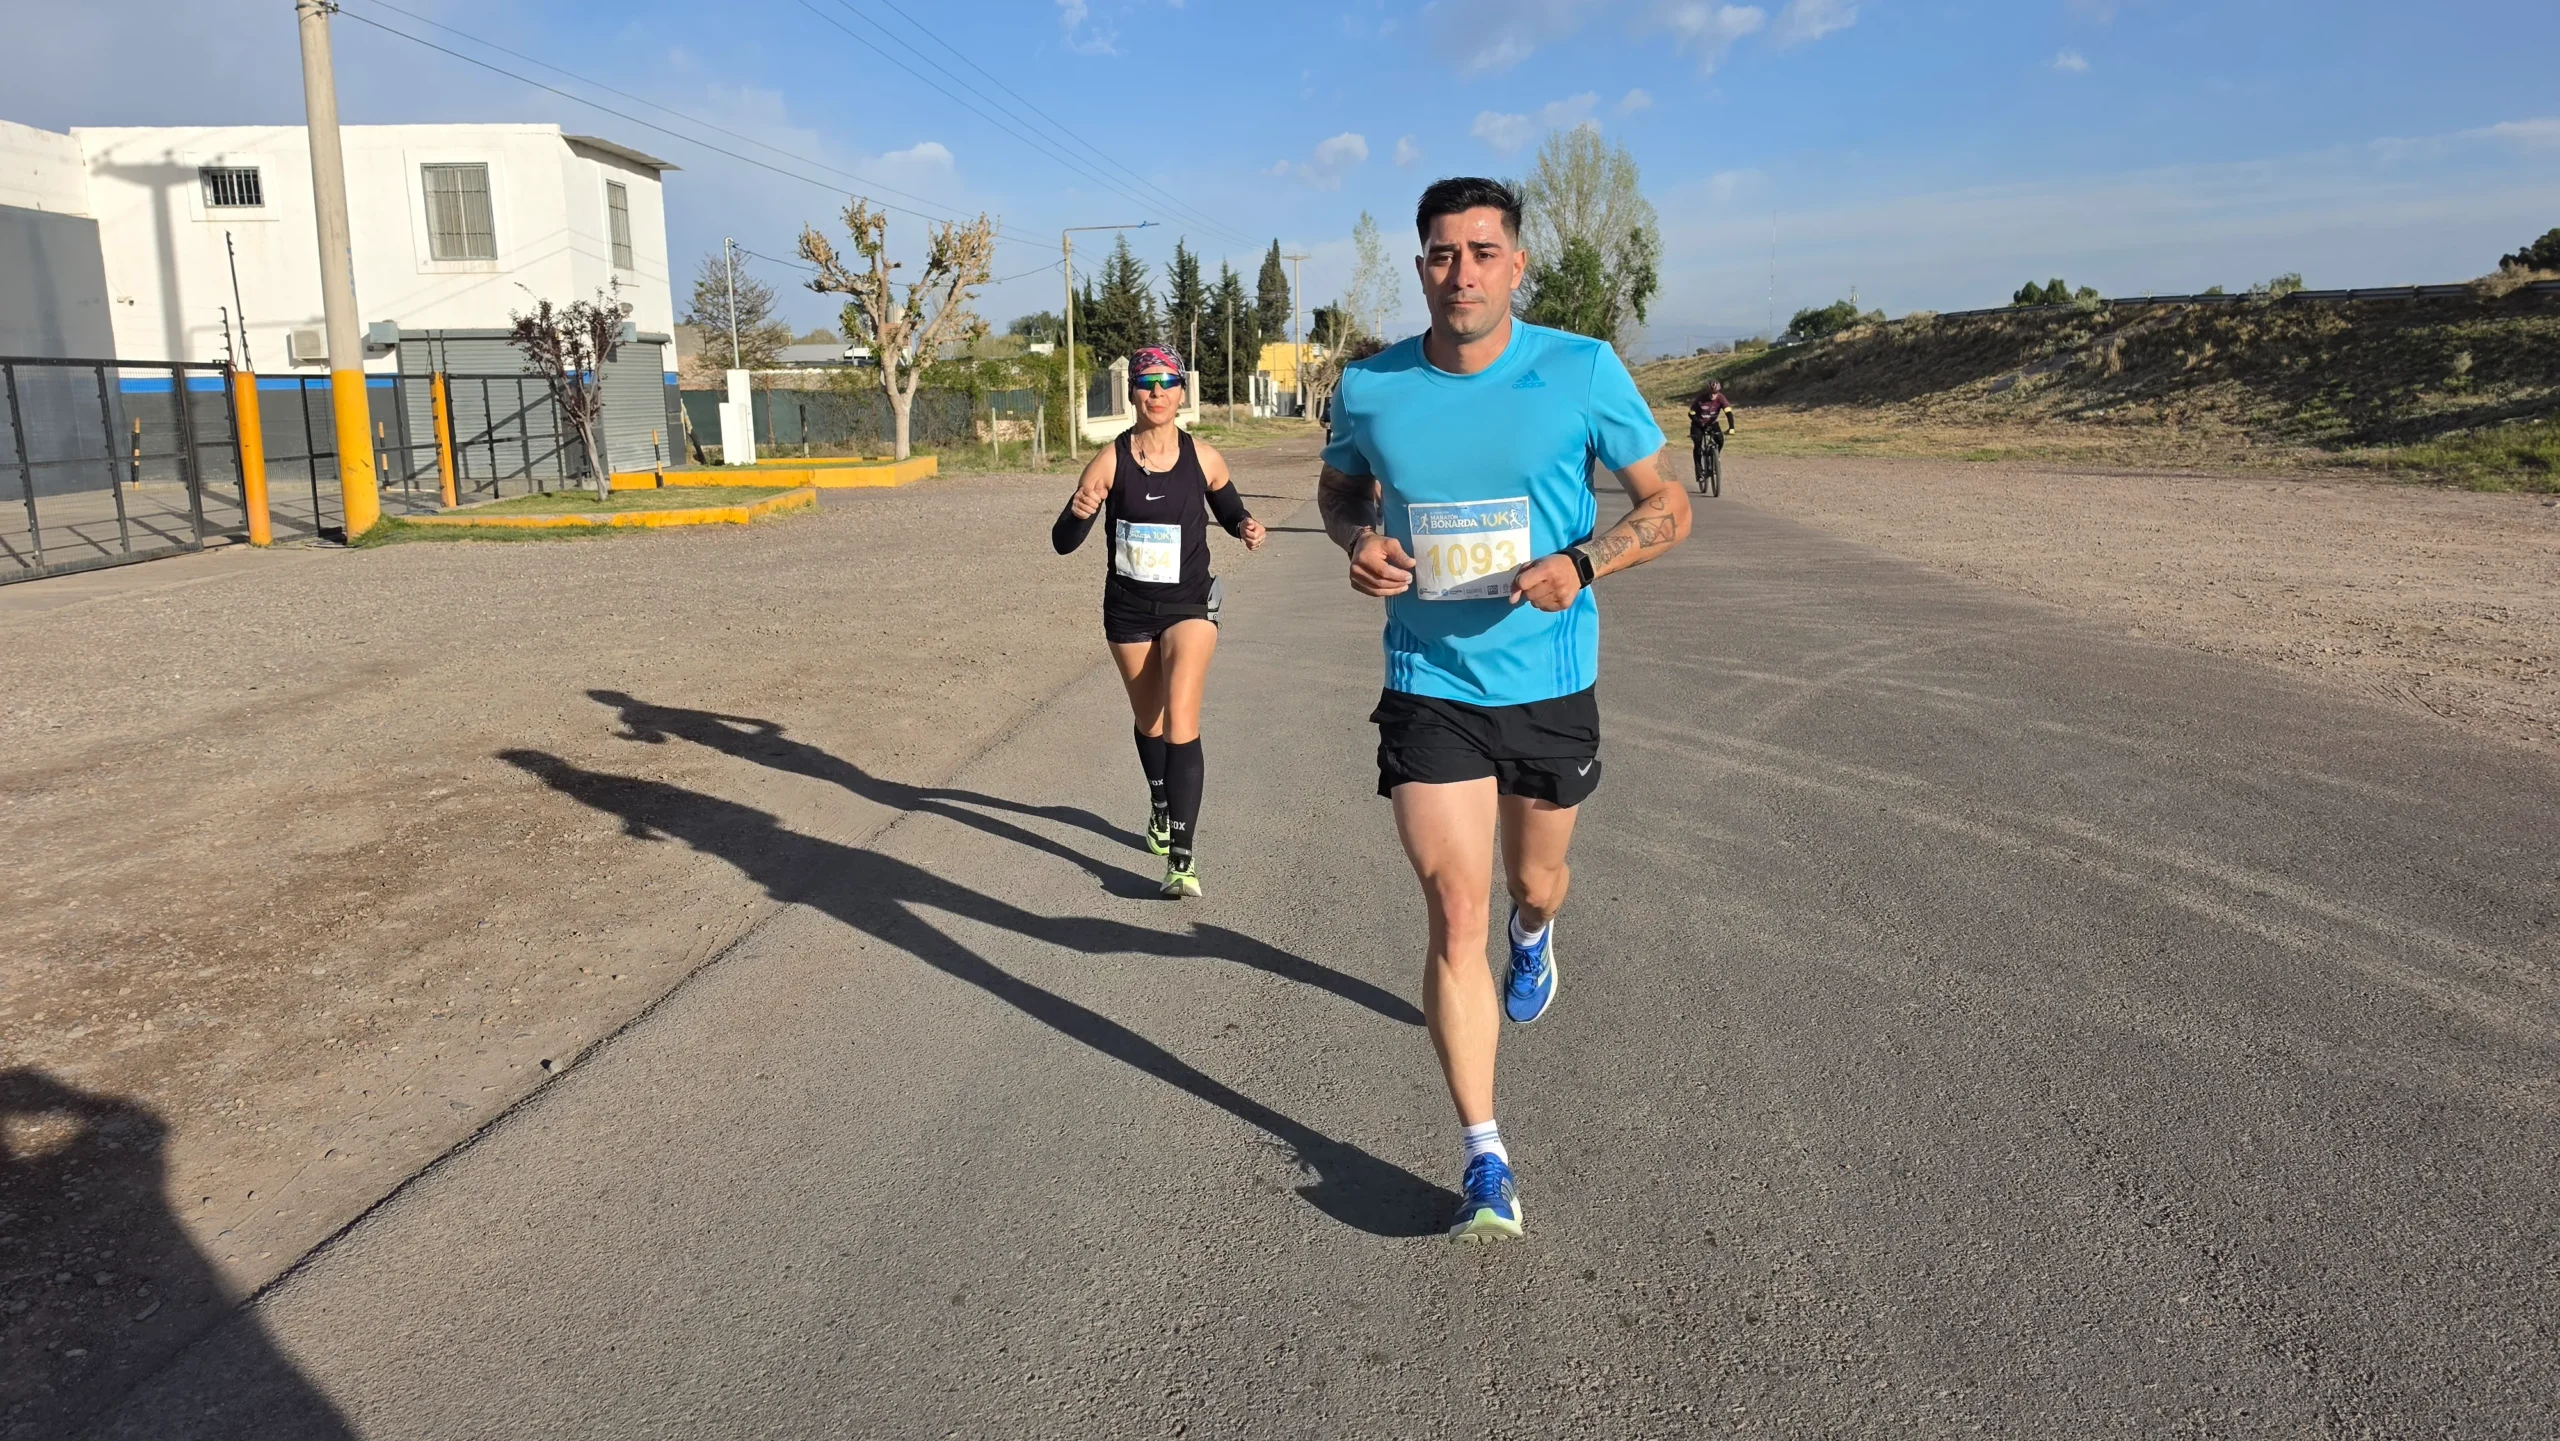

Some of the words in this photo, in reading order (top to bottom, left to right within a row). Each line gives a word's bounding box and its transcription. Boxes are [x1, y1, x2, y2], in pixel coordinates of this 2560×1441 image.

[1511, 381, 1547, 389] adidas
[1431, 519, 1478, 528] BONARDA
[1480, 512, 1508, 526] 10K
[1427, 540, 1517, 577] 1093
[1149, 778, 1164, 787] OX
